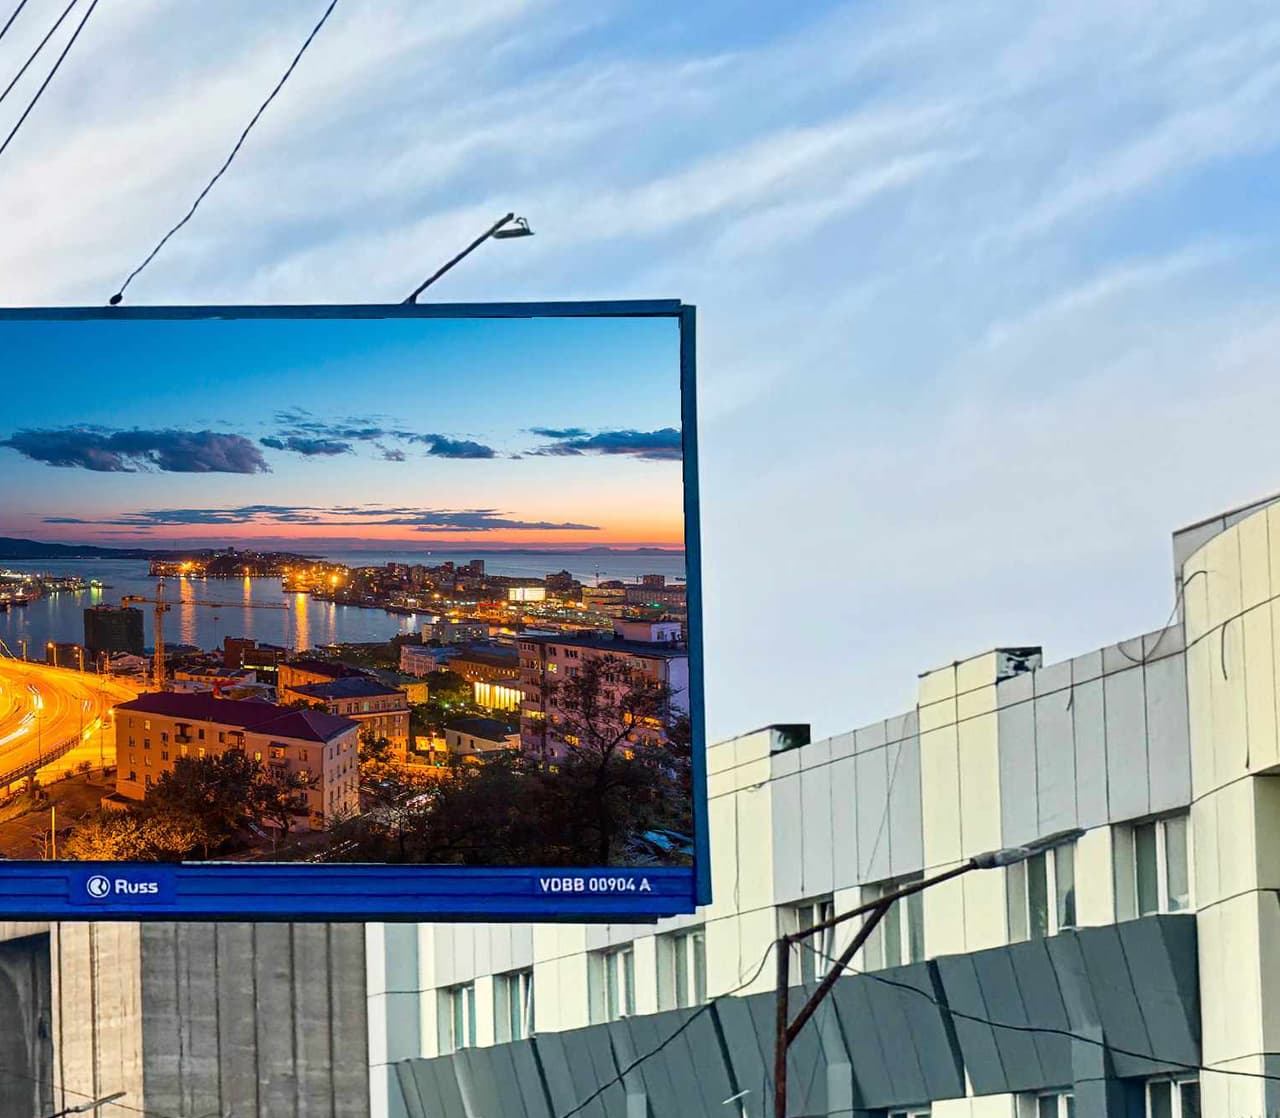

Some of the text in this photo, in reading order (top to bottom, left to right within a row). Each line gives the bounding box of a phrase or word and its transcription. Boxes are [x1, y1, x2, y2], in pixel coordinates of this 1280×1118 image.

[115, 879, 159, 895] Russ
[589, 878, 636, 891] 00904
[639, 878, 652, 891] A
